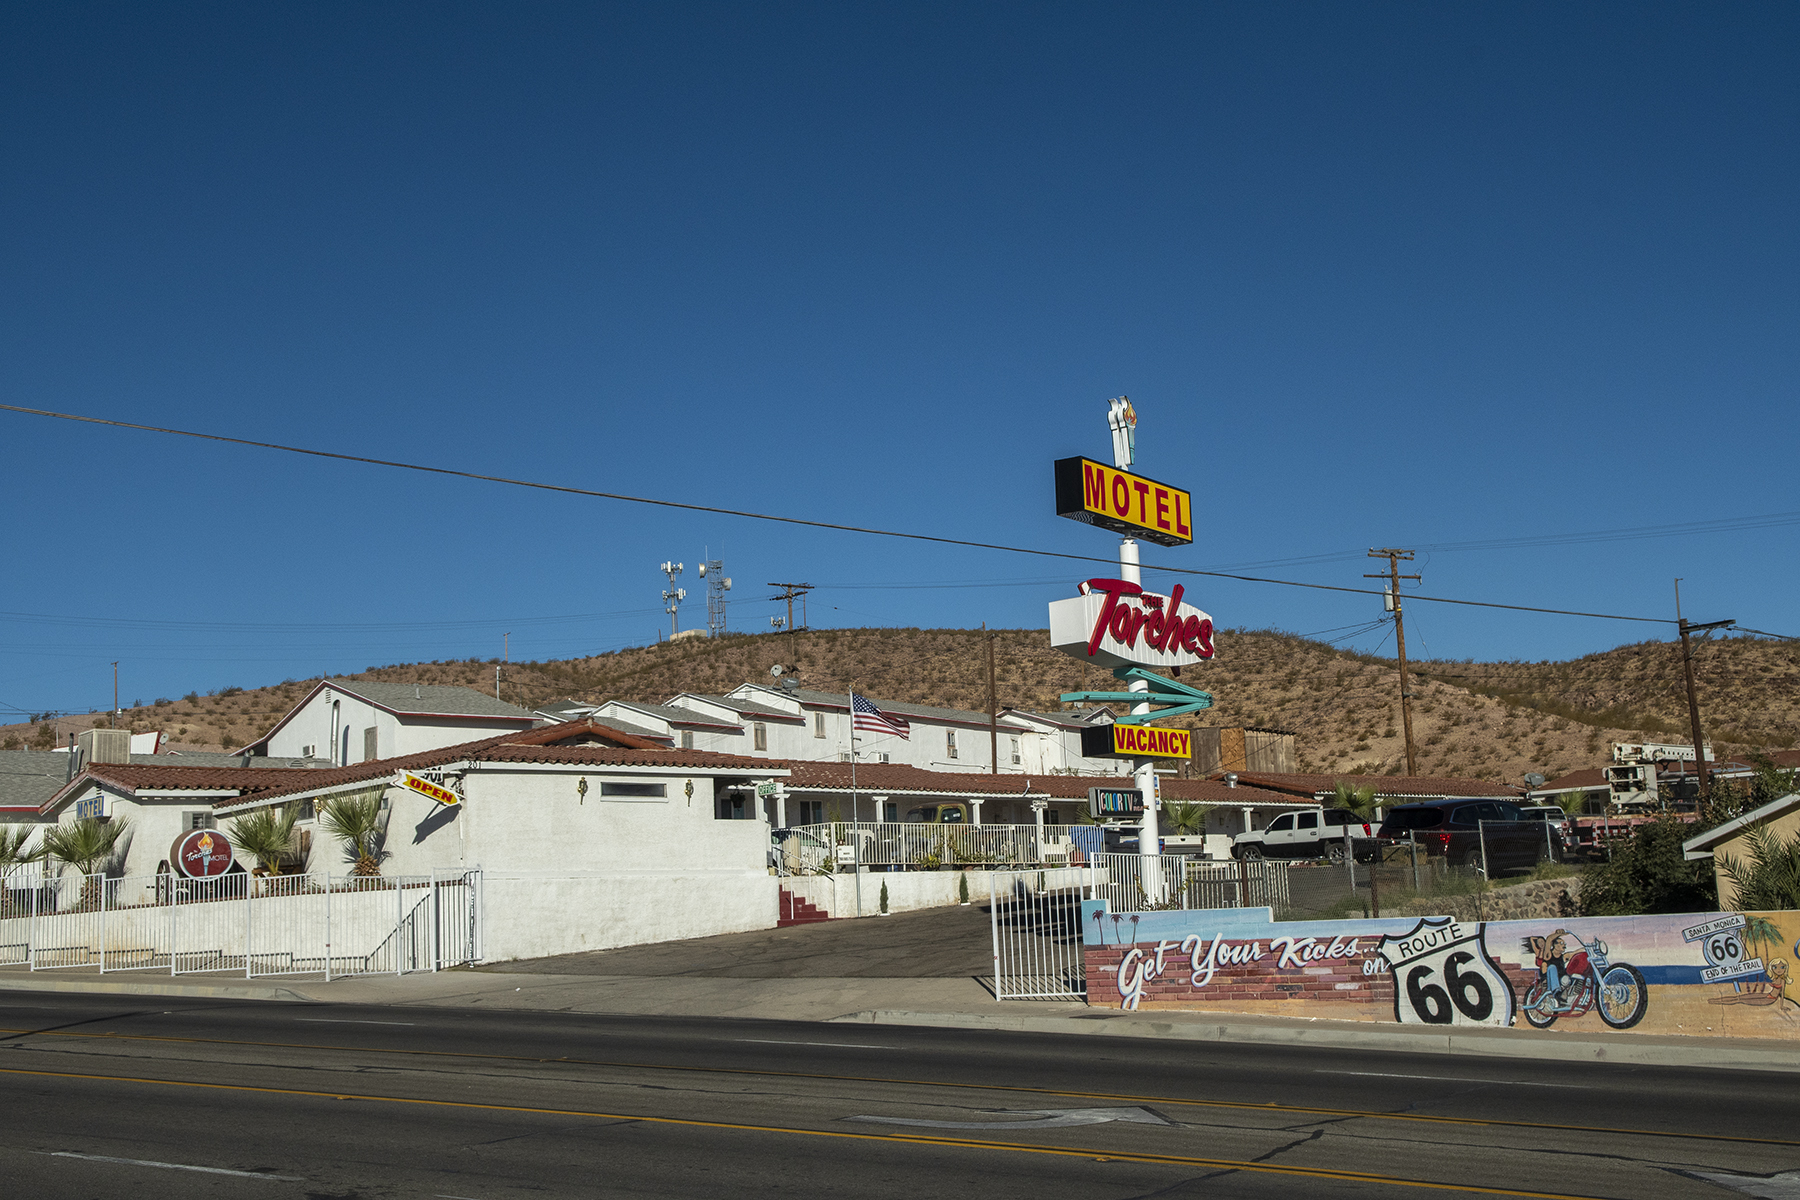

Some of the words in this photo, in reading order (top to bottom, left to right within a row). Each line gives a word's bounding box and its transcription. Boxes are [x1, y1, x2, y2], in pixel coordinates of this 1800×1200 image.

[1084, 463, 1189, 537] MOTEL
[1141, 594, 1164, 609] THE
[1077, 578, 1214, 661] Torches
[1114, 727, 1189, 755] VACANCY
[468, 760, 481, 769] 201
[409, 778, 454, 803] OPEN
[759, 782, 776, 795] OFFICE
[77, 797, 103, 819] MOTEL
[1100, 792, 1123, 812] COLOR
[1123, 793, 1133, 812] TV
[208, 854, 229, 862] MOTEL
[1688, 925, 1711, 938] SANTA
[1713, 917, 1741, 929] MONICA
[1398, 923, 1464, 959] ROUTE
[1711, 936, 1739, 961] 66
[1118, 939, 1180, 1010] Get
[1180, 932, 1267, 988] Your
[1363, 954, 1390, 976] on
[1705, 968, 1719, 979] END
[1720, 966, 1730, 975] OF
[1730, 963, 1742, 974] THE
[1742, 960, 1761, 971] TRAIL
[1406, 951, 1493, 1025] 66
